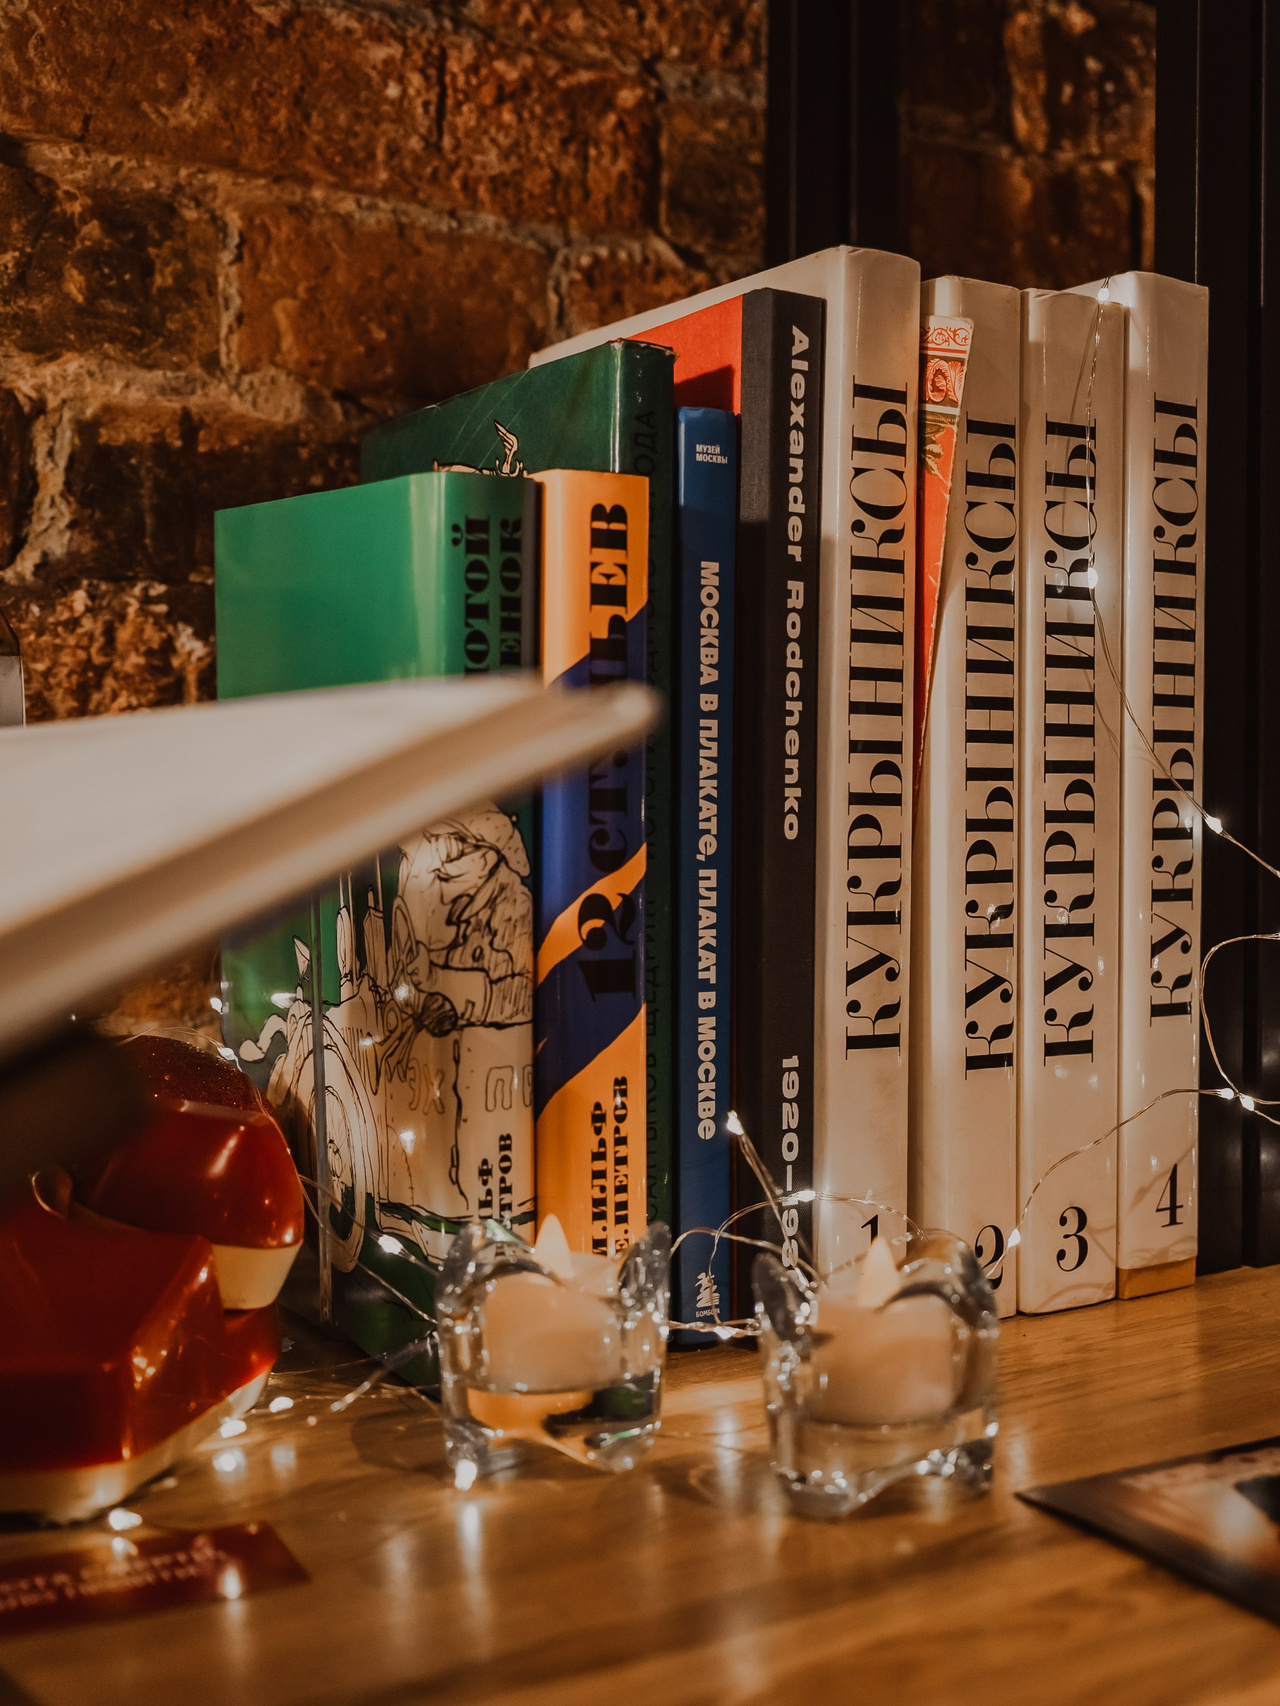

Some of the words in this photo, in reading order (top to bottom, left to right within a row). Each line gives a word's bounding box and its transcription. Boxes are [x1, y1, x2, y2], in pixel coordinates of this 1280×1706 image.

[695, 443, 721, 455] МУЗЕЙ
[695, 453, 728, 465] МОСКВЫ
[787, 324, 811, 563] Alexander
[699, 560, 720, 686] МОСКВА
[588, 502, 629, 875] СТЬЕВ
[699, 692, 719, 712] В
[783, 579, 805, 841] Rodchenko
[846, 375, 908, 1060] КУКРЫНИКСЫ
[963, 411, 1017, 1081] КУКРЫНИКСЫ
[1043, 412, 1098, 1067] КУКРЫНИКСЫ
[1150, 391, 1199, 1027] КУКРЫНИКСЫ
[577, 893, 638, 1004] 12
[698, 868, 718, 984] ПЛАКАТ
[698, 990, 717, 1010] В
[1055, 1205, 1089, 1273] 3
[1154, 1162, 1185, 1229] 4
[695, 1307, 721, 1318] БОМБА
